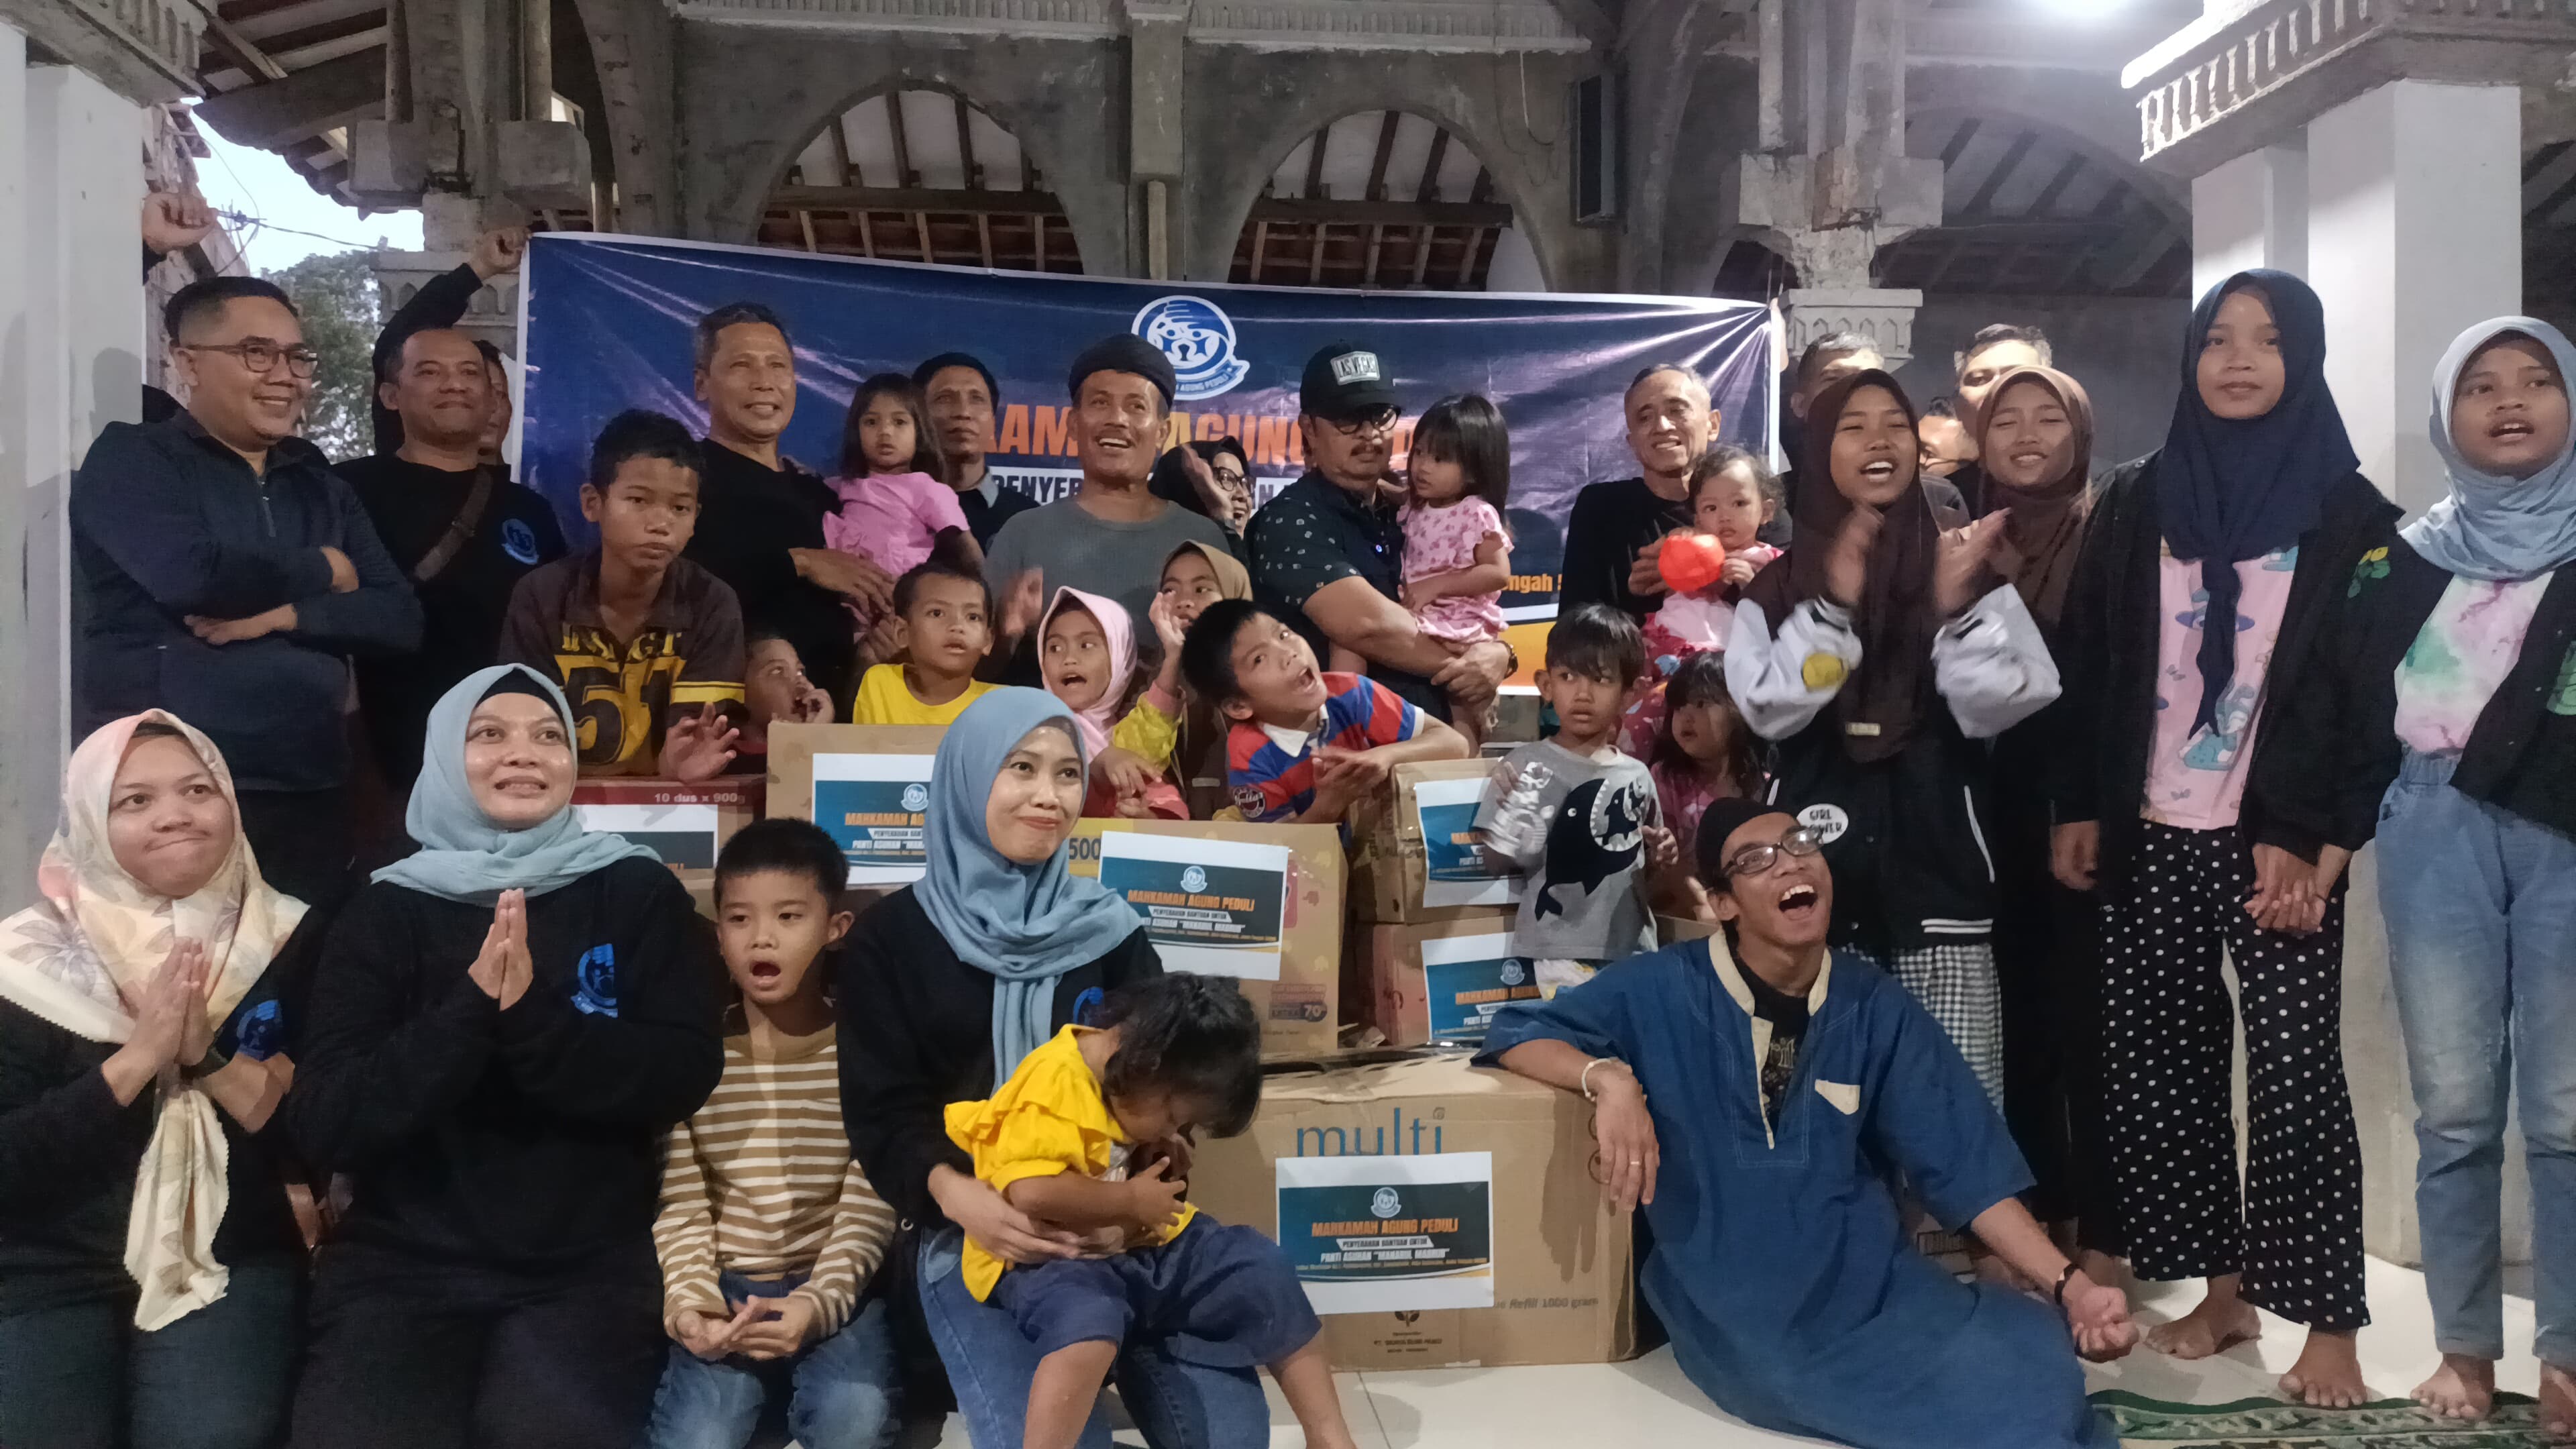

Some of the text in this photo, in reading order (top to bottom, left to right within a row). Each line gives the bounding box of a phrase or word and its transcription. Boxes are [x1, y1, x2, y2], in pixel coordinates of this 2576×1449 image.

[655, 793, 670, 802] 10
[674, 793, 697, 802] dus
[1222, 896, 1255, 912] PEDULI
[1381, 1219, 1419, 1235] AGUNG
[1421, 1218, 1459, 1233] PEDULI
